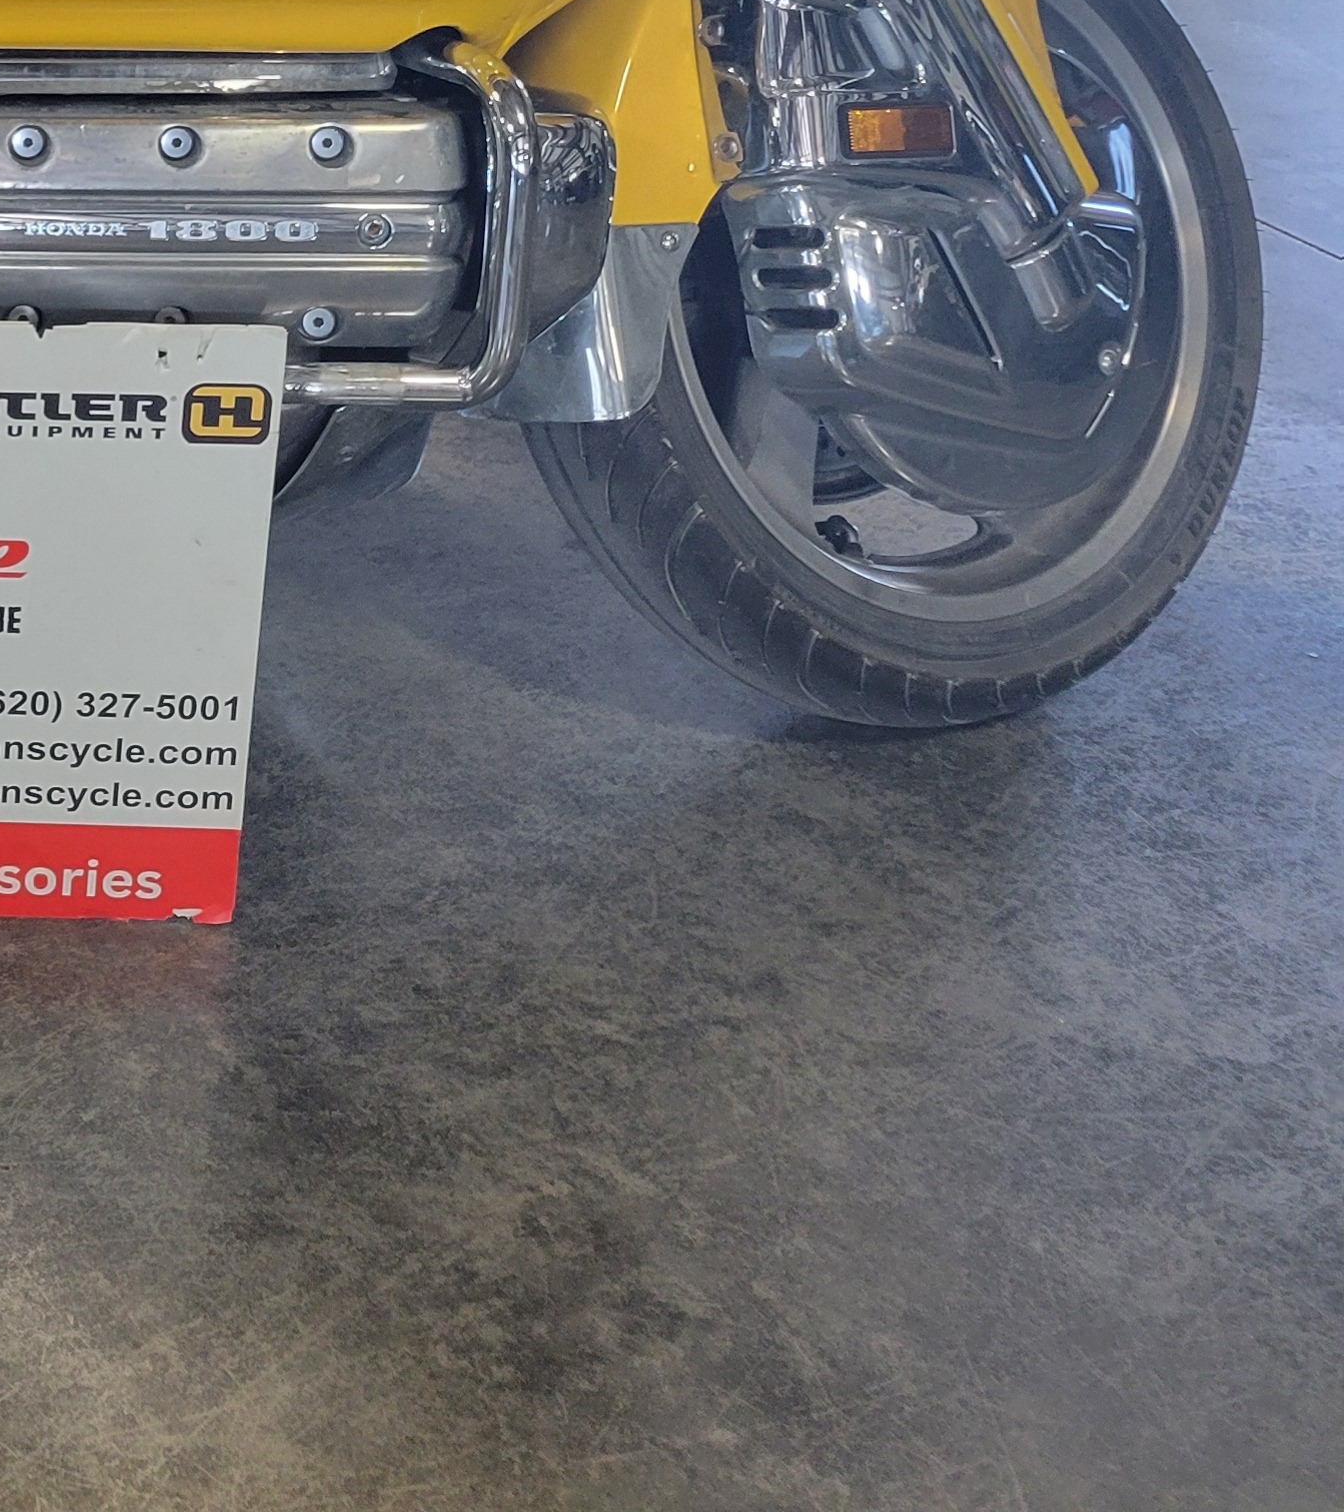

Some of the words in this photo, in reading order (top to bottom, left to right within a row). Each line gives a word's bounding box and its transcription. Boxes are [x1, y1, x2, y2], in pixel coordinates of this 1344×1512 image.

[23, 222, 127, 237] HONDA
[139, 220, 318, 241] 1800
[76, 692, 238, 721] 327-5001
